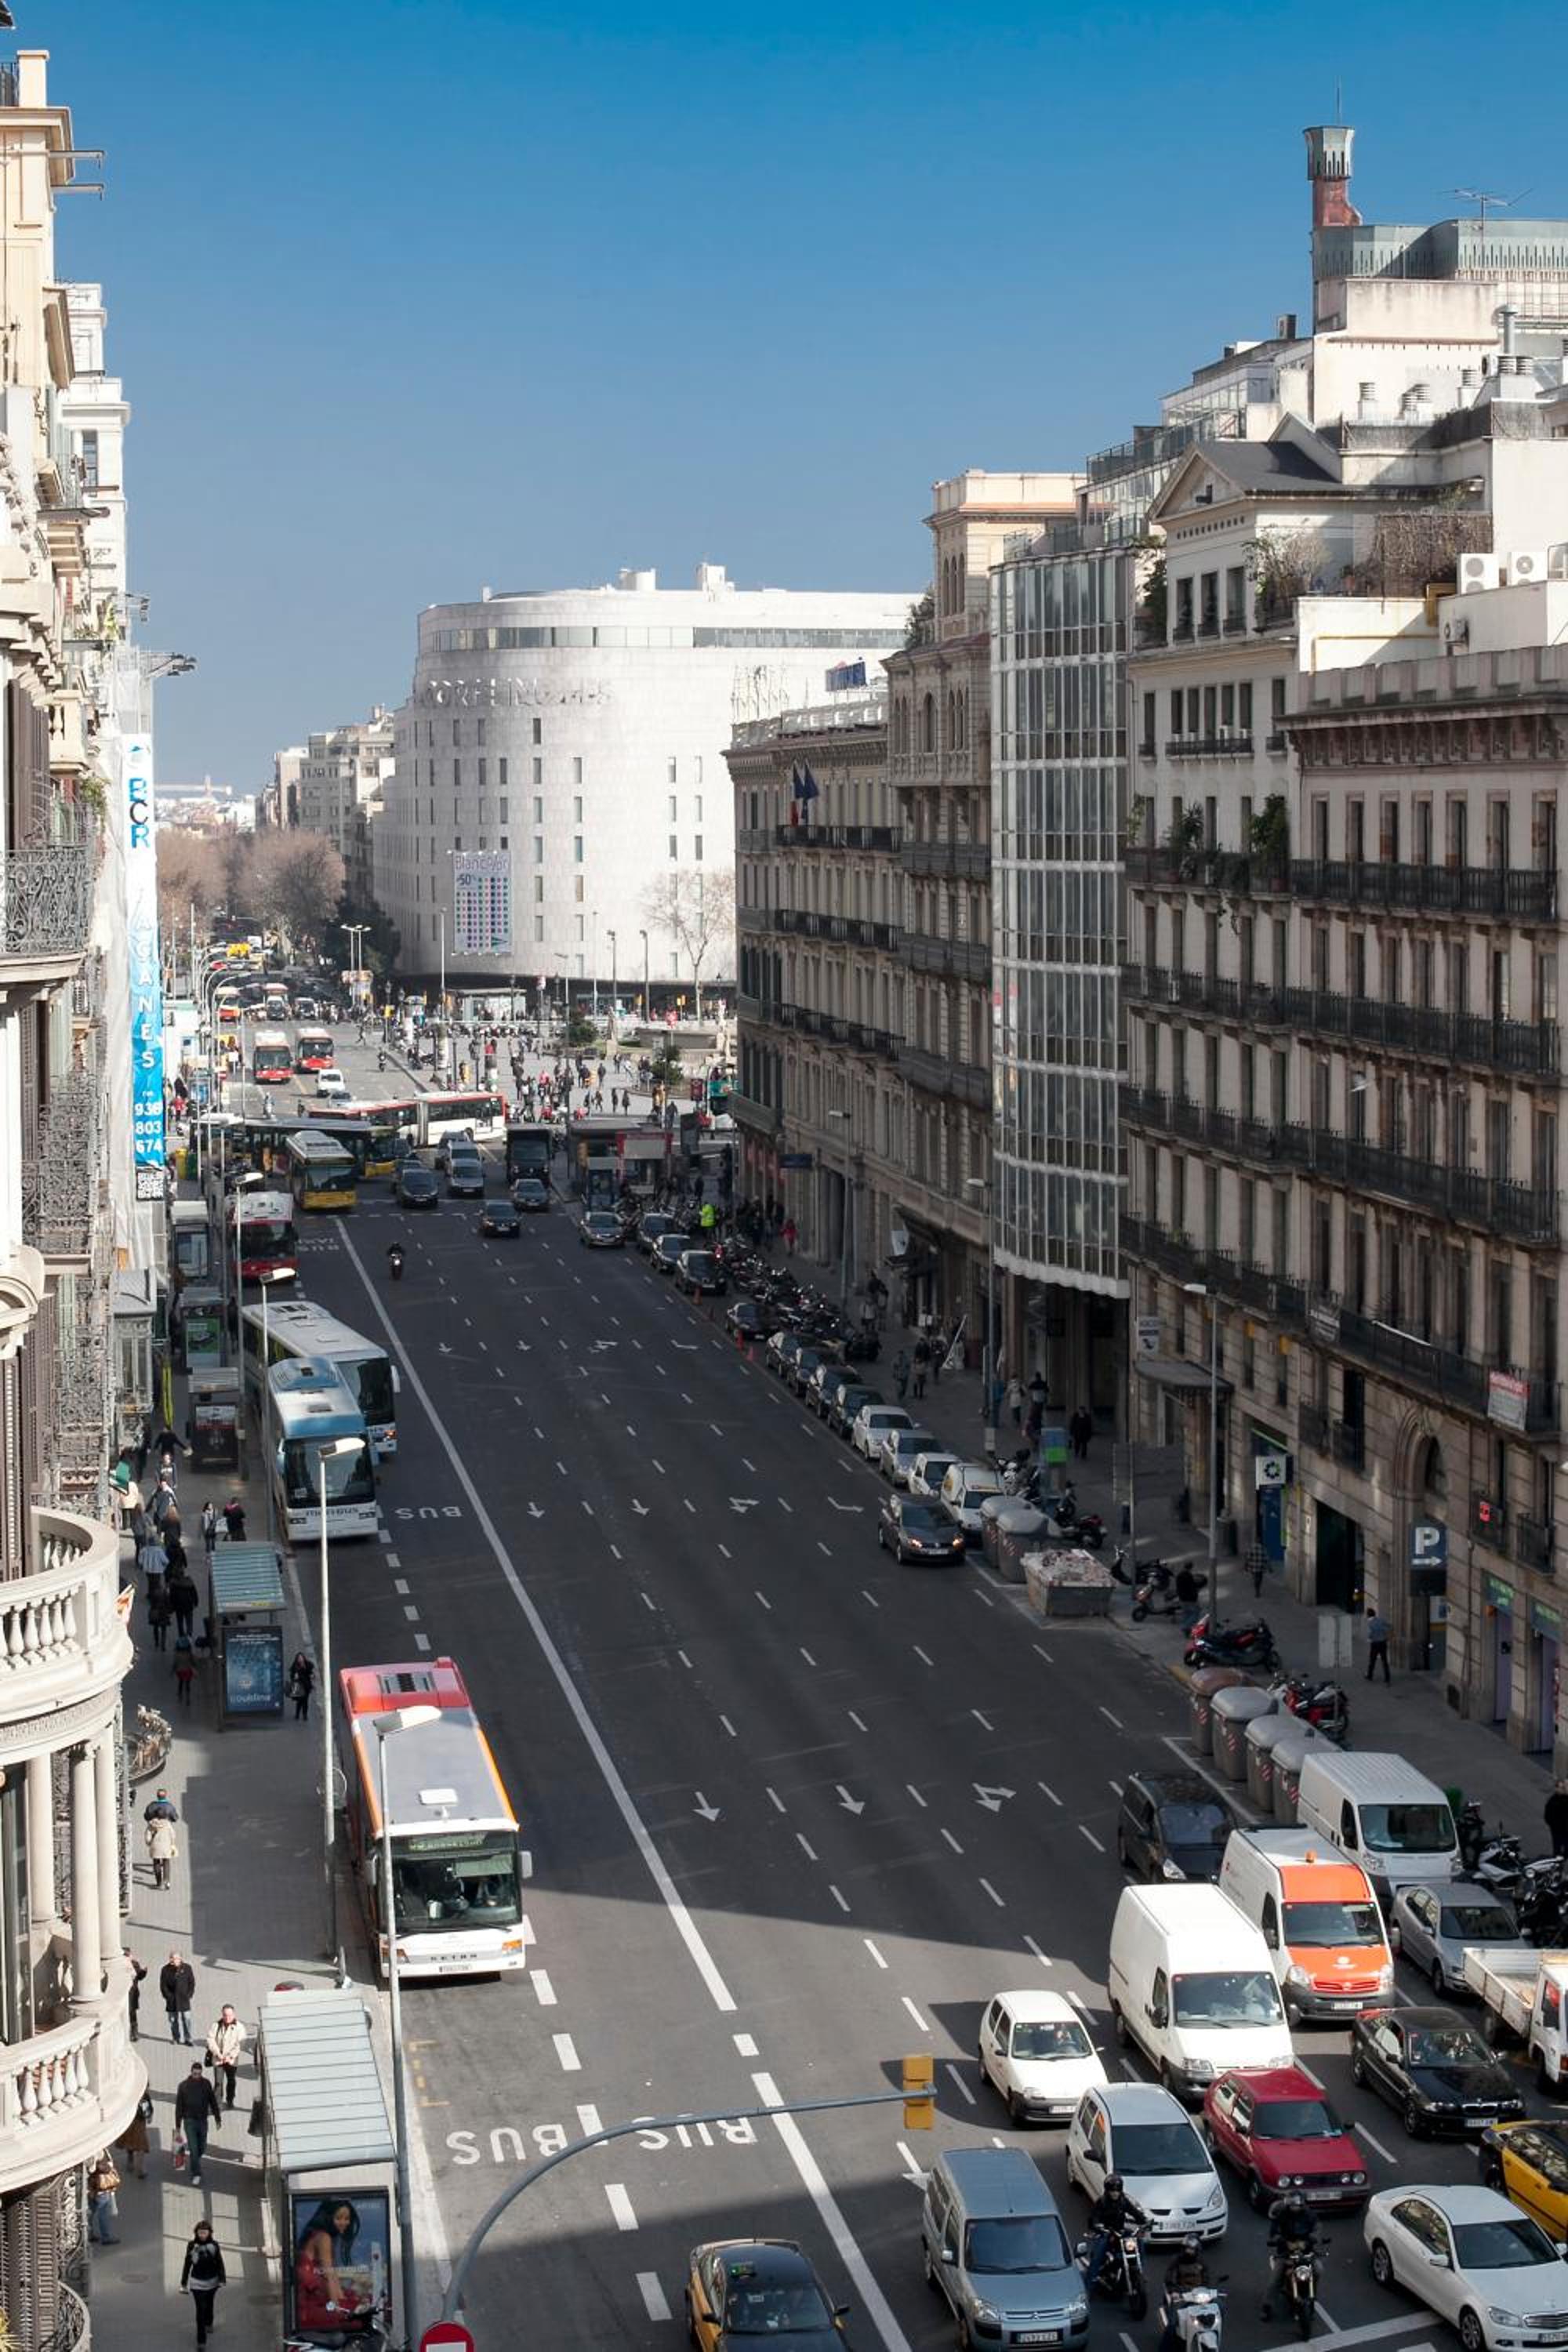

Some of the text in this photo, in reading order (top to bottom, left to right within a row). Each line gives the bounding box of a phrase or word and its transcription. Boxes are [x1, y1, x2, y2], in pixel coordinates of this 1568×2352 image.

[136, 1121, 162, 1135] 803
[136, 1138, 162, 1155] 674
[395, 1505, 462, 1519] BUS
[1415, 1526, 1440, 1554] P
[446, 2123, 568, 2166] BUS
